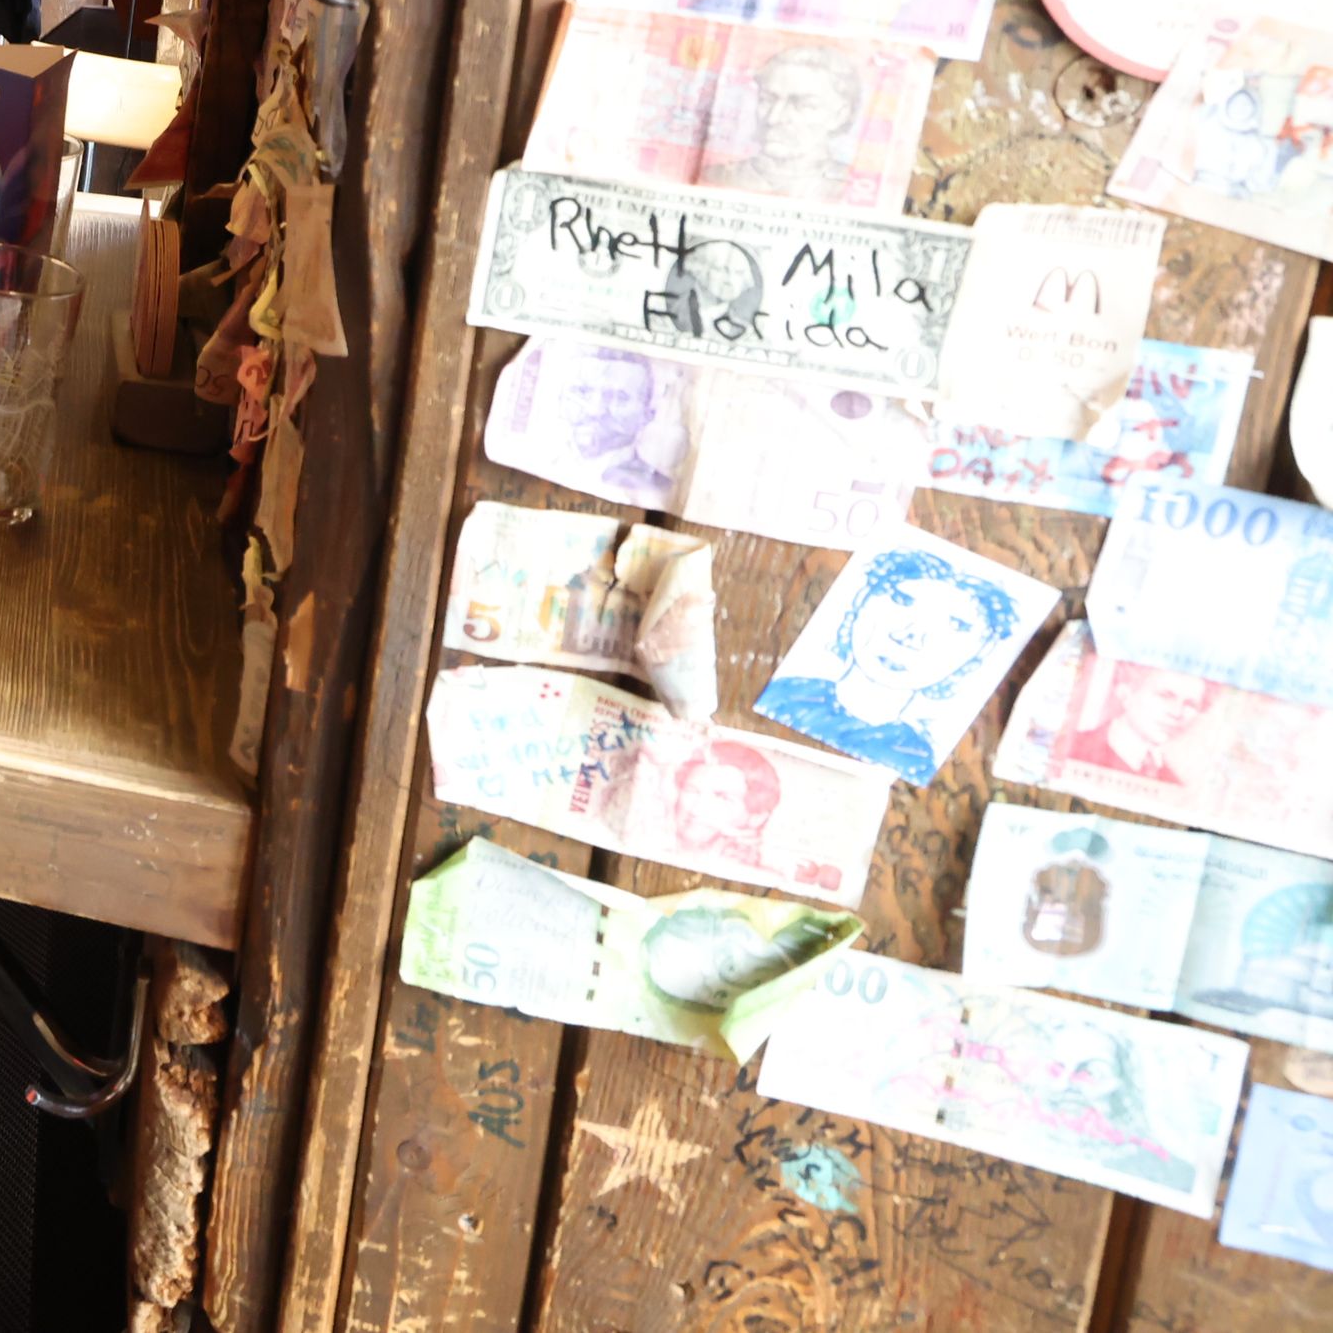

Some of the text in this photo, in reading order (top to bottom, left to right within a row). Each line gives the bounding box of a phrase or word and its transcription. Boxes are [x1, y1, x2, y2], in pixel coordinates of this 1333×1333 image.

[781, 243, 934, 312] Mila
[643, 288, 889, 351] Florida
[1069, 330, 1119, 354] Bon
[808, 487, 882, 539] 50
[1139, 484, 1279, 538] 1000
[461, 601, 502, 643] 5
[463, 942, 502, 991] 50
